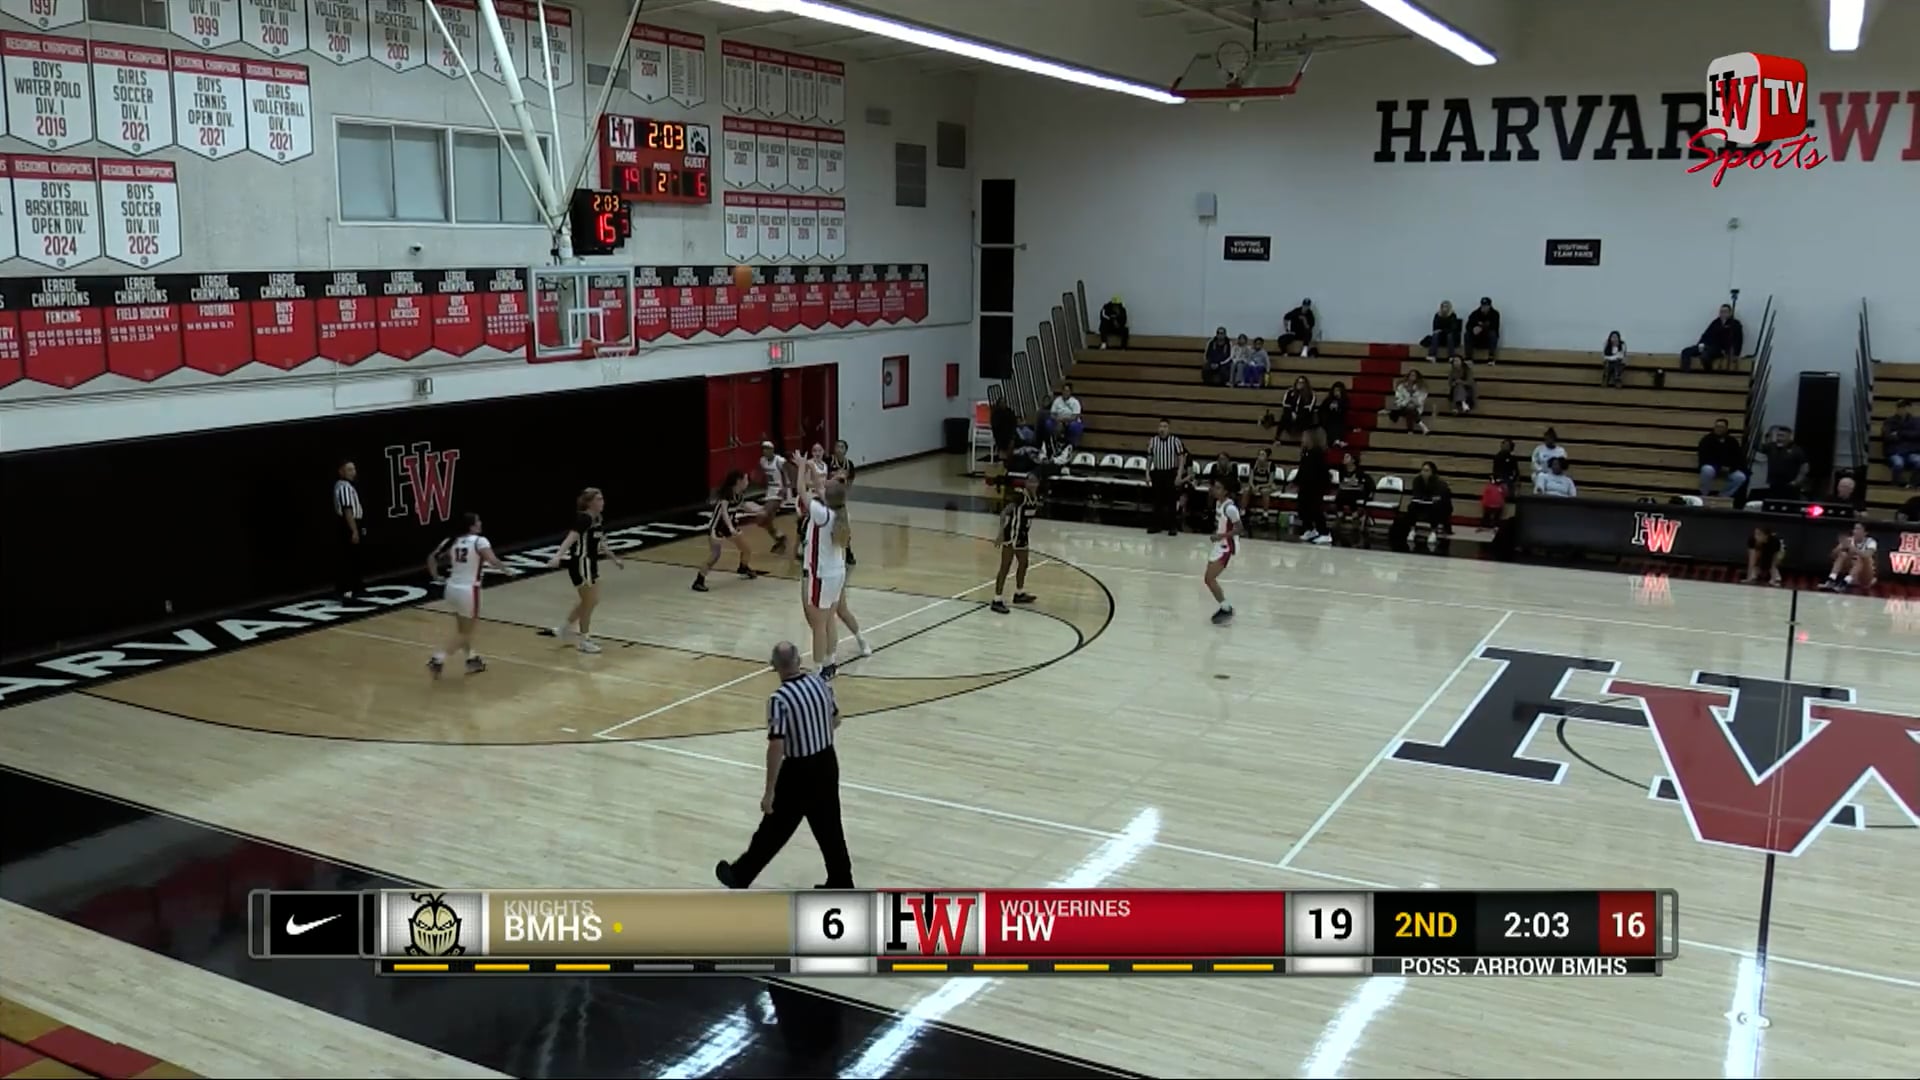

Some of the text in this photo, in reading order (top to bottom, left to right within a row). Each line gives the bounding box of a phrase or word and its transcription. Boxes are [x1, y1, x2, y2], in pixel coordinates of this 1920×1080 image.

[193, 17, 219, 37] 1999
[262, 25, 288, 46] 2000
[327, 34, 351, 54] 2001
[33, 61, 62, 79] BOYS
[117, 68, 147, 85] GIRLS
[14, 78, 81, 98] WATER POLO
[197, 77, 222, 93] BOYS
[265, 84, 291, 99] GIRLS
[113, 85, 153, 103] SOCCER
[193, 93, 227, 110] TENNIS
[35, 97, 58, 115] DIV.
[121, 104, 142, 120] DIV.
[252, 99, 305, 117] VOLLEYBALL
[188, 109, 234, 127] OPEN DIV.
[269, 116, 286, 131] DIV.
[36, 116, 67, 137] 2019
[122, 121, 150, 142] 2021
[1374, 92, 1774, 162] HARVAR
[200, 127, 226, 146] 2021
[269, 132, 293, 151] 2021
[648, 122, 684, 150] 2:03
[615, 151, 706, 169] HOME GUEST
[41, 182, 71, 198] BOYS
[625, 168, 707, 197] 19 2 6
[126, 184, 154, 199] BOYS
[25, 199, 89, 217] BASKETBALL
[121, 201, 161, 217] SOCCER
[32, 218, 86, 234] OPEN DIV.
[126, 219, 160, 234] DIV. III
[599, 213, 616, 243] 15
[43, 236, 77, 256] 2024
[128, 236, 159, 254] 2025
[42, 278, 77, 292] LEAGUE
[124, 277, 156, 290] LEAGUE
[200, 275, 228, 288] LEAGUE
[269, 273, 296, 286] LEAGUE
[333, 273, 358, 284] LEAGUE
[115, 289, 168, 304] CHAMPIONS
[191, 287, 240, 301] CHAMPIONS
[260, 285, 305, 299] CHAMPIONS
[325, 284, 367, 297] CHAMPIONS
[31, 291, 90, 307] CHAMPIONS
[275, 301, 294, 313] BOYS
[45, 310, 82, 324] FENCING
[116, 306, 170, 320] FIELD HOCKEY
[199, 304, 235, 316] FOOTBALL
[277, 312, 293, 325] GOLF
